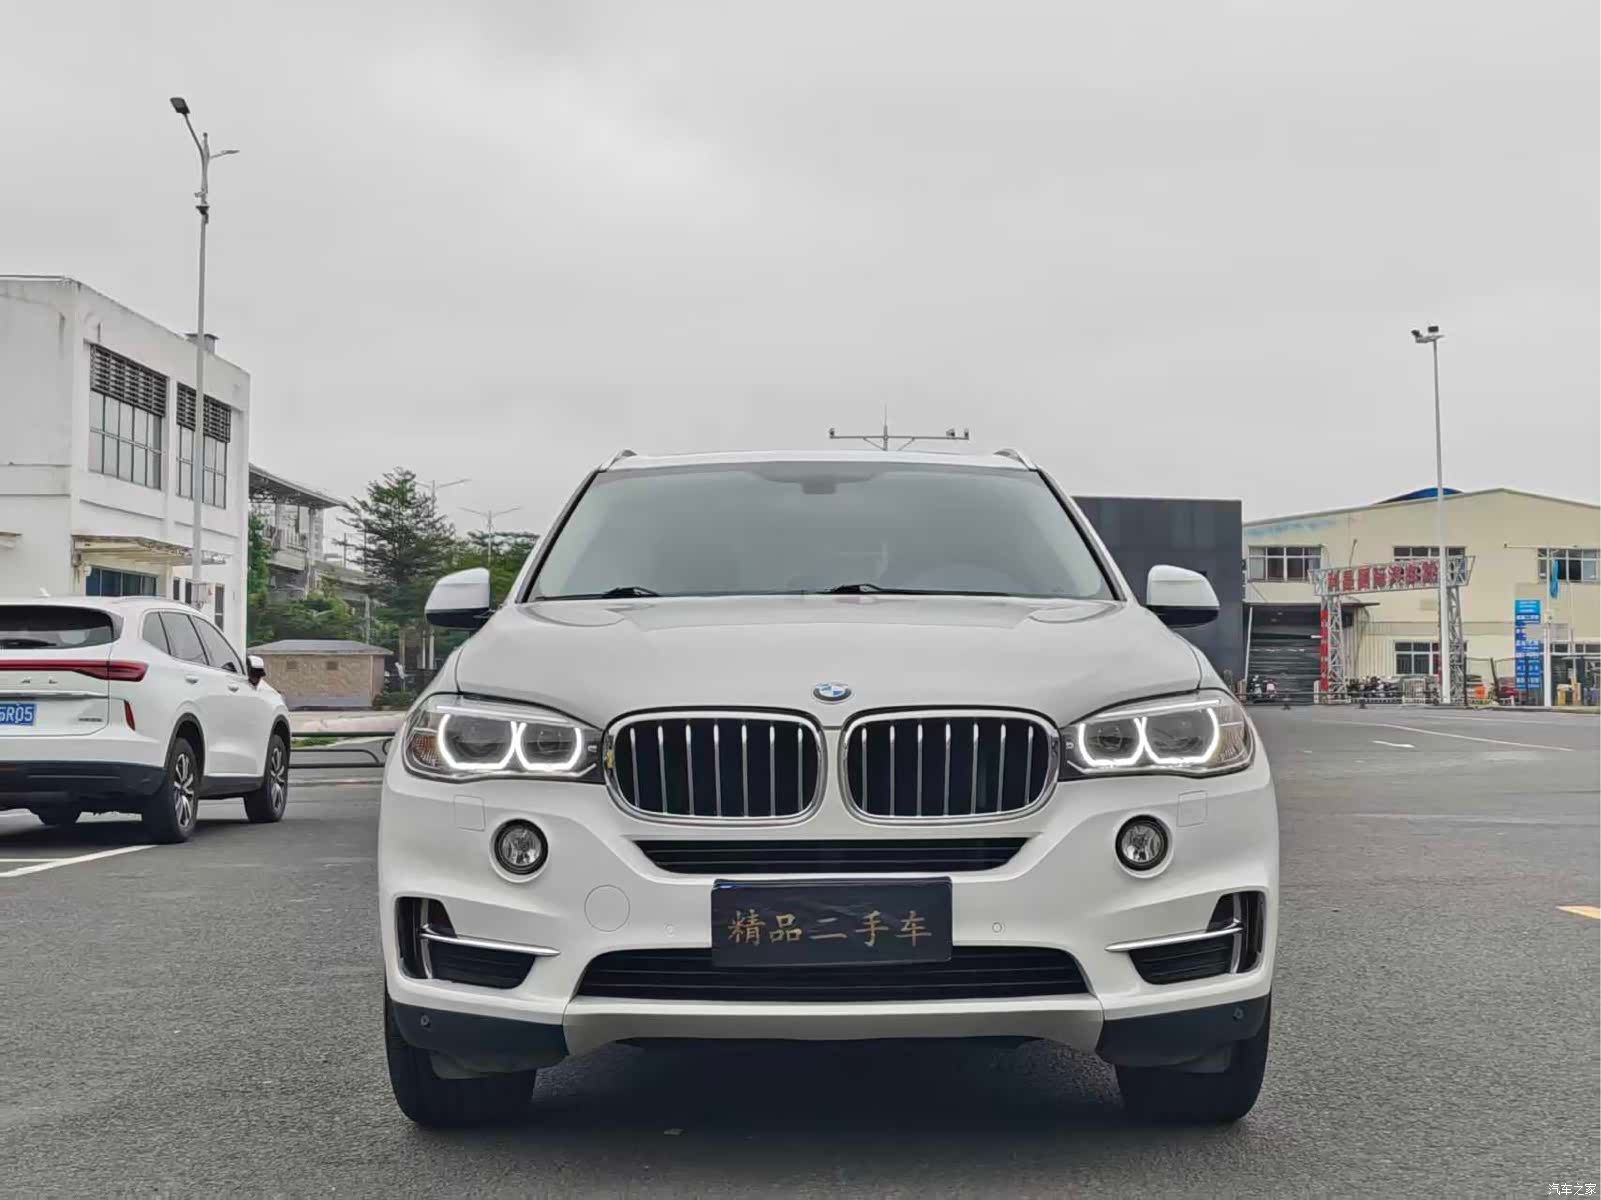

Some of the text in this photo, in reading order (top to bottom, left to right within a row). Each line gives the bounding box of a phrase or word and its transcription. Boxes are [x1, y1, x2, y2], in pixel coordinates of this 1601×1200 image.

[727, 909, 932, 947] 精品二手车
